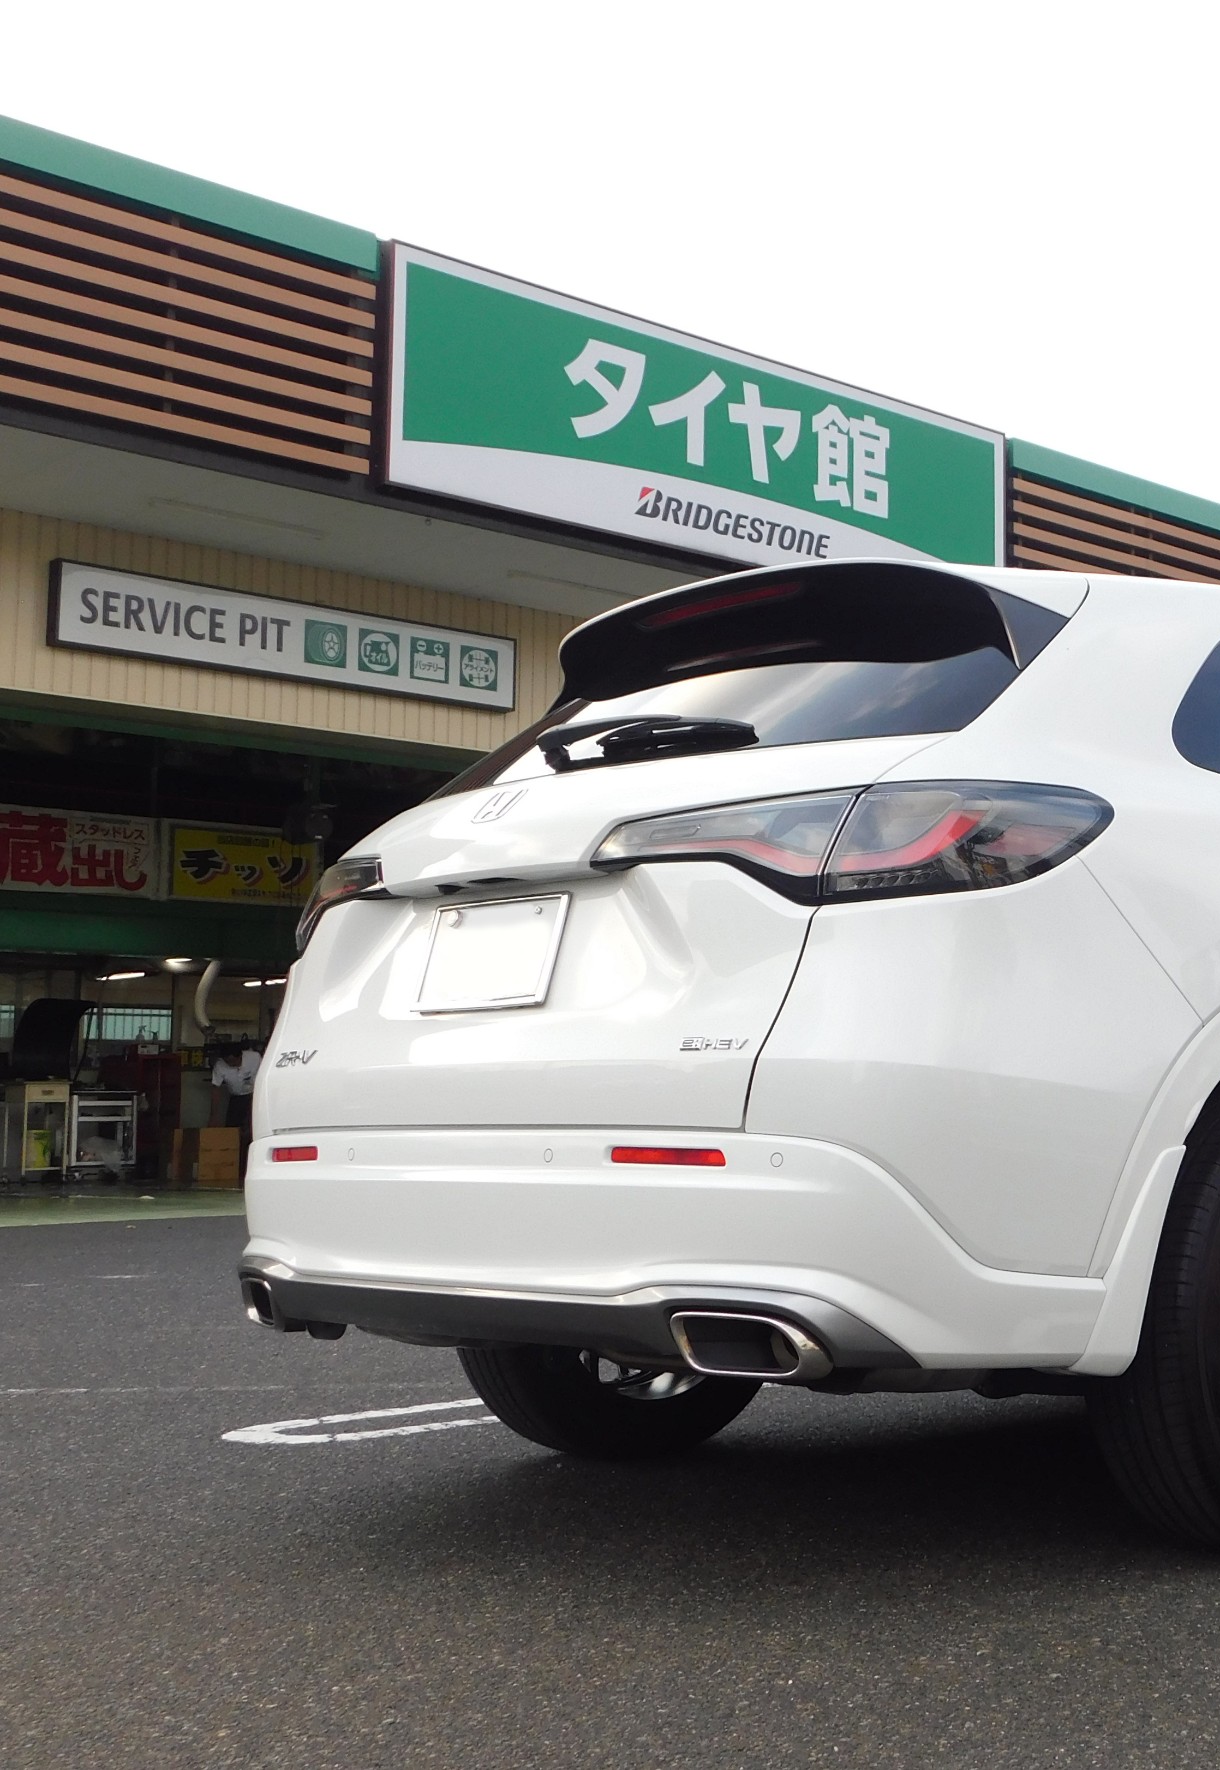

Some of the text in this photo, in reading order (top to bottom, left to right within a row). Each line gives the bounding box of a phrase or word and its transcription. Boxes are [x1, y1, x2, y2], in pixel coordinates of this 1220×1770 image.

[564, 339, 889, 519] タイヤ館
[635, 486, 831, 559] BRIDGESTONE
[80, 588, 291, 652] SERVICE PIT
[370, 651, 388, 663] オイル
[415, 660, 444, 672] バッテリー
[463, 662, 494, 674] アライメント
[76, 823, 145, 840] スタッドレス
[0, 810, 147, 891] 蔵出し
[179, 849, 307, 885] チッソ
